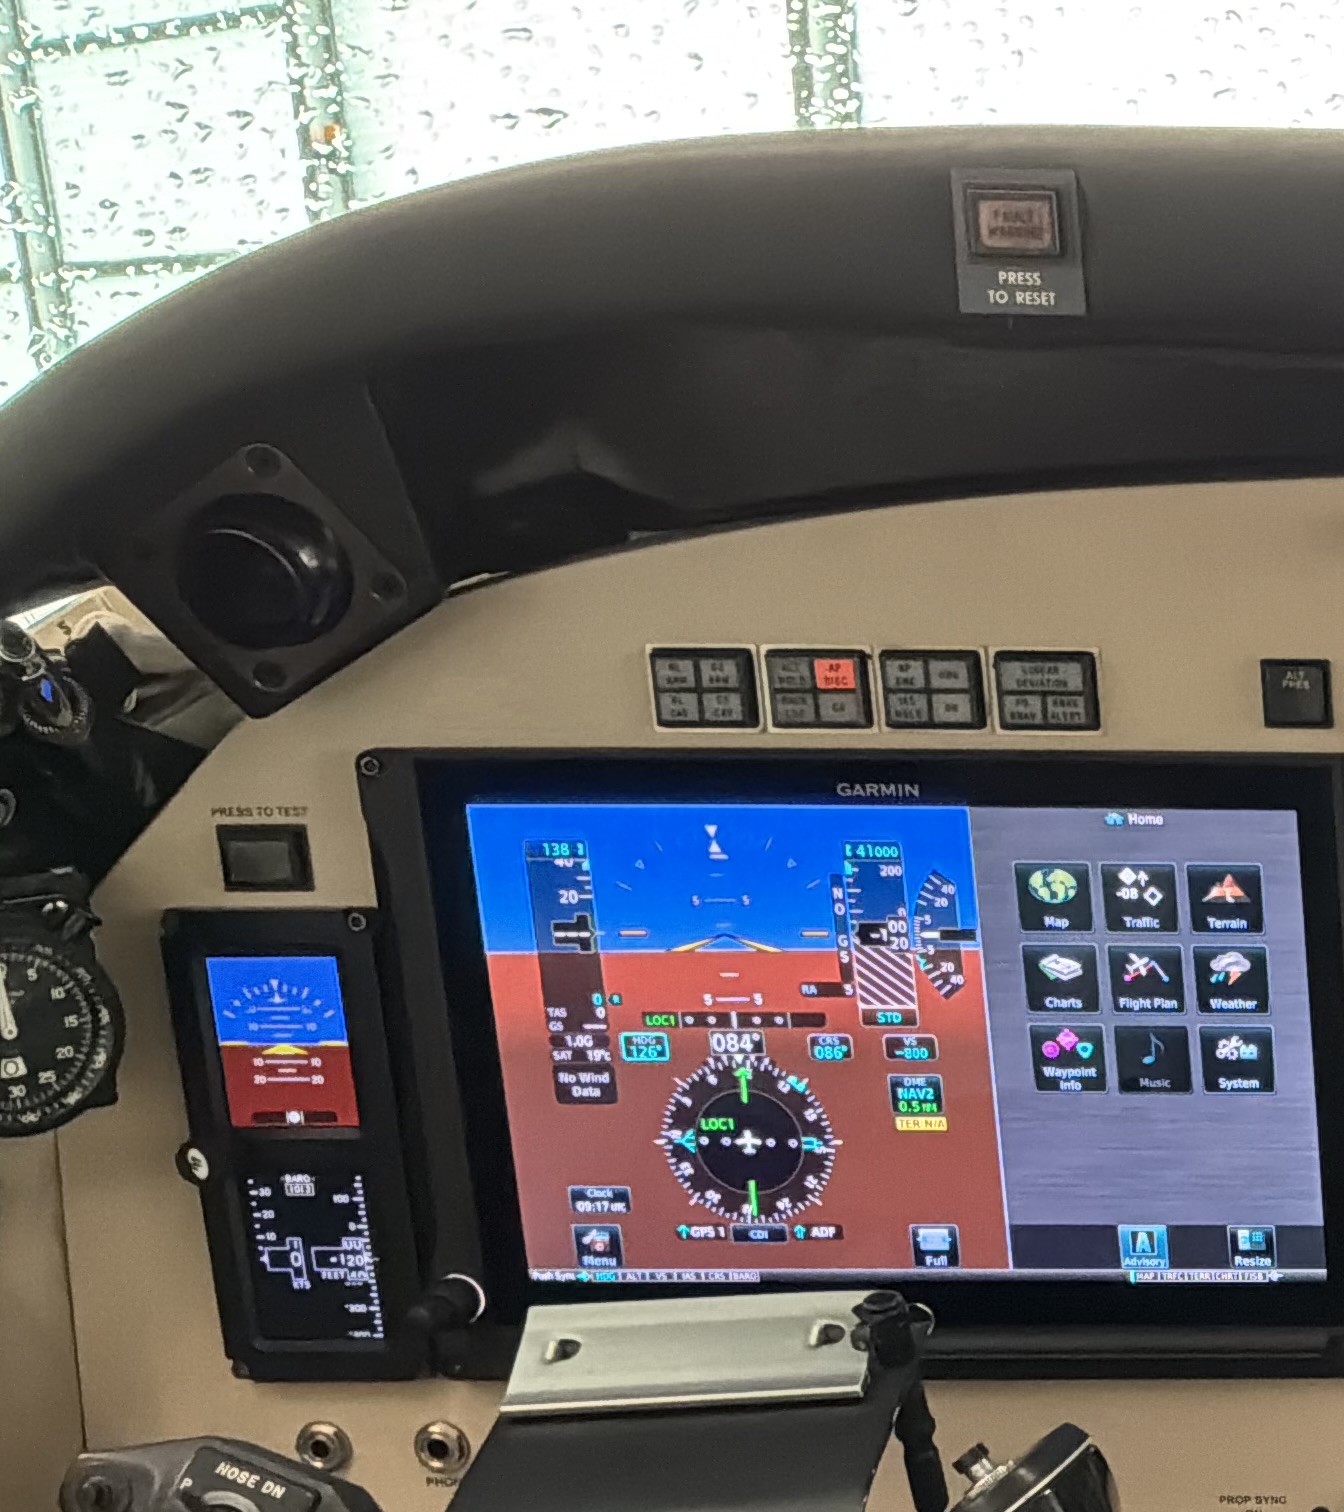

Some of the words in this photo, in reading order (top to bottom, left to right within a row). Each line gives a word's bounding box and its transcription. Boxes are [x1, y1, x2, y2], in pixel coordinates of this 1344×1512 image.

[998, 271, 1041, 286] PRESS
[988, 289, 1009, 304] TO
[1016, 291, 1056, 306] RESET
[837, 783, 920, 797] GARMIN
[255, 807, 274, 818] TO
[277, 807, 308, 818] TEST
[1128, 813, 1163, 825] Home
[856, 844, 899, 858] 41000
[1044, 916, 1069, 930] Map
[1124, 916, 1160, 928] Traffic
[1207, 917, 1247, 929] Terrain
[1046, 997, 1082, 1009] Charts
[1119, 997, 1151, 1011] Flight
[1154, 997, 1178, 1009] Plan
[1210, 998, 1257, 1010] Weather
[645, 1013, 675, 1026] LOC1
[877, 1011, 902, 1024] STD
[712, 1033, 761, 1052] 084°
[558, 1072, 575, 1085] No
[579, 1072, 609, 1085] Wind
[1043, 1066, 1097, 1080] Waypoint
[1060, 1079, 1082, 1092] Info
[1139, 1077, 1170, 1088] Music
[1218, 1078, 1260, 1091] System
[572, 1085, 601, 1098] Data
[897, 1087, 934, 1100] NAV2
[700, 1117, 734, 1131] LOC1
[811, 1228, 836, 1240] ADF
[583, 1254, 616, 1267] Menu
[925, 1254, 948, 1267] Full
[1234, 1256, 1271, 1267] Resize
[216, 1460, 257, 1491] NOSE
[261, 1478, 286, 1500] DN
